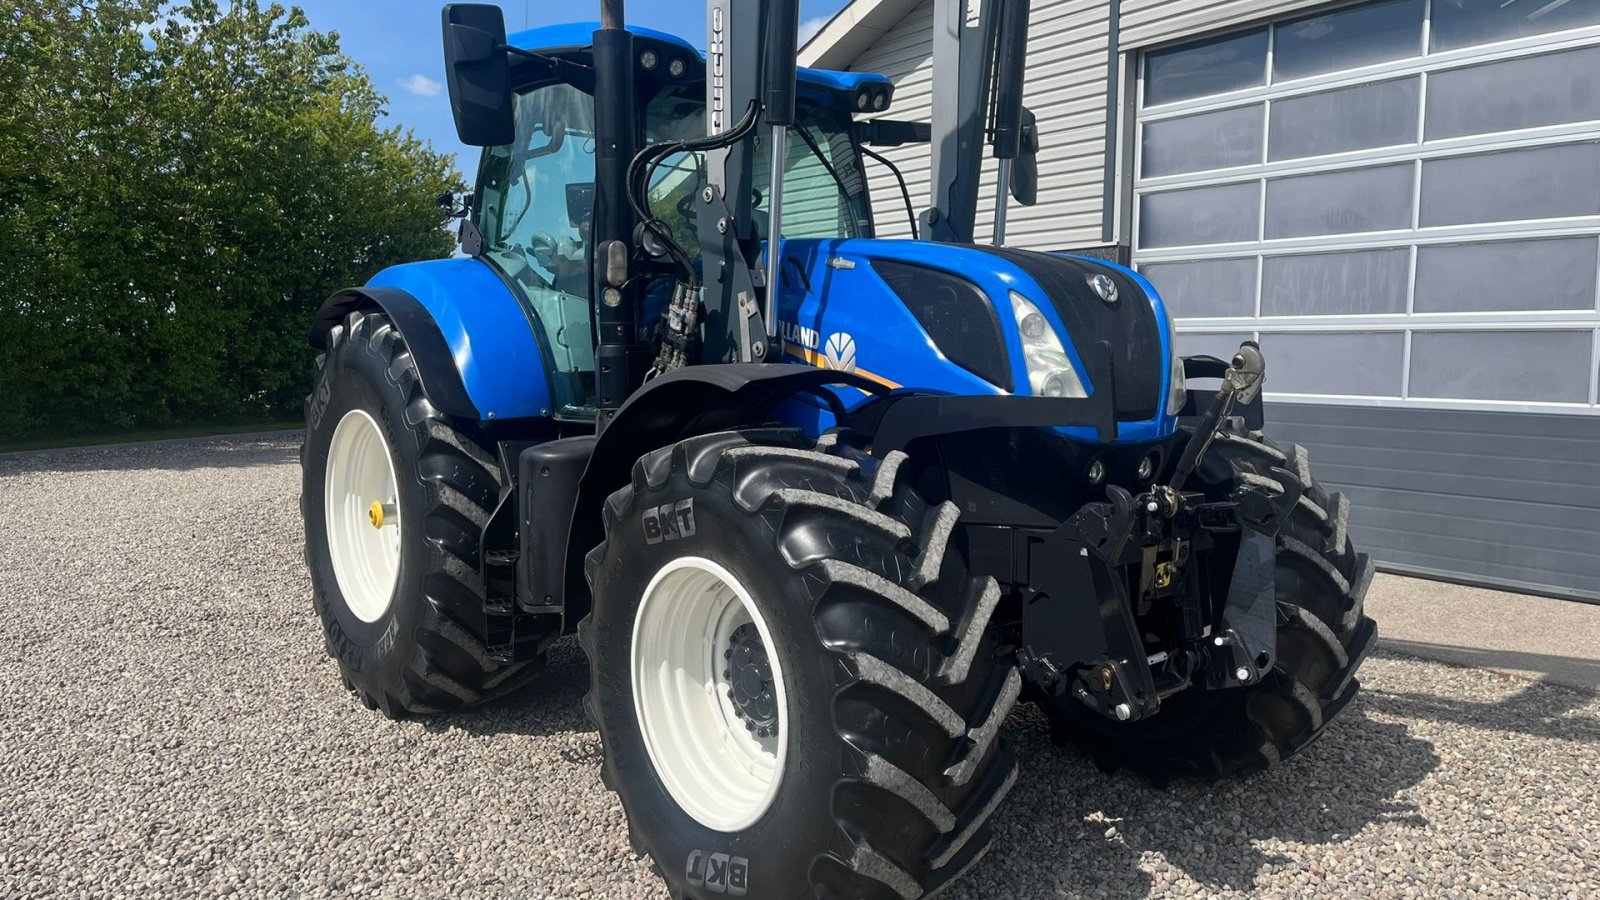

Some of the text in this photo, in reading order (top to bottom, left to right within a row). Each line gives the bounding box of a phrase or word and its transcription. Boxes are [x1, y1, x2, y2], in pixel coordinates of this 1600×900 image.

[779, 319, 820, 350] LLAND
[310, 368, 331, 431] BKT
[642, 498, 695, 545] BKT
[686, 850, 748, 896] BKT
